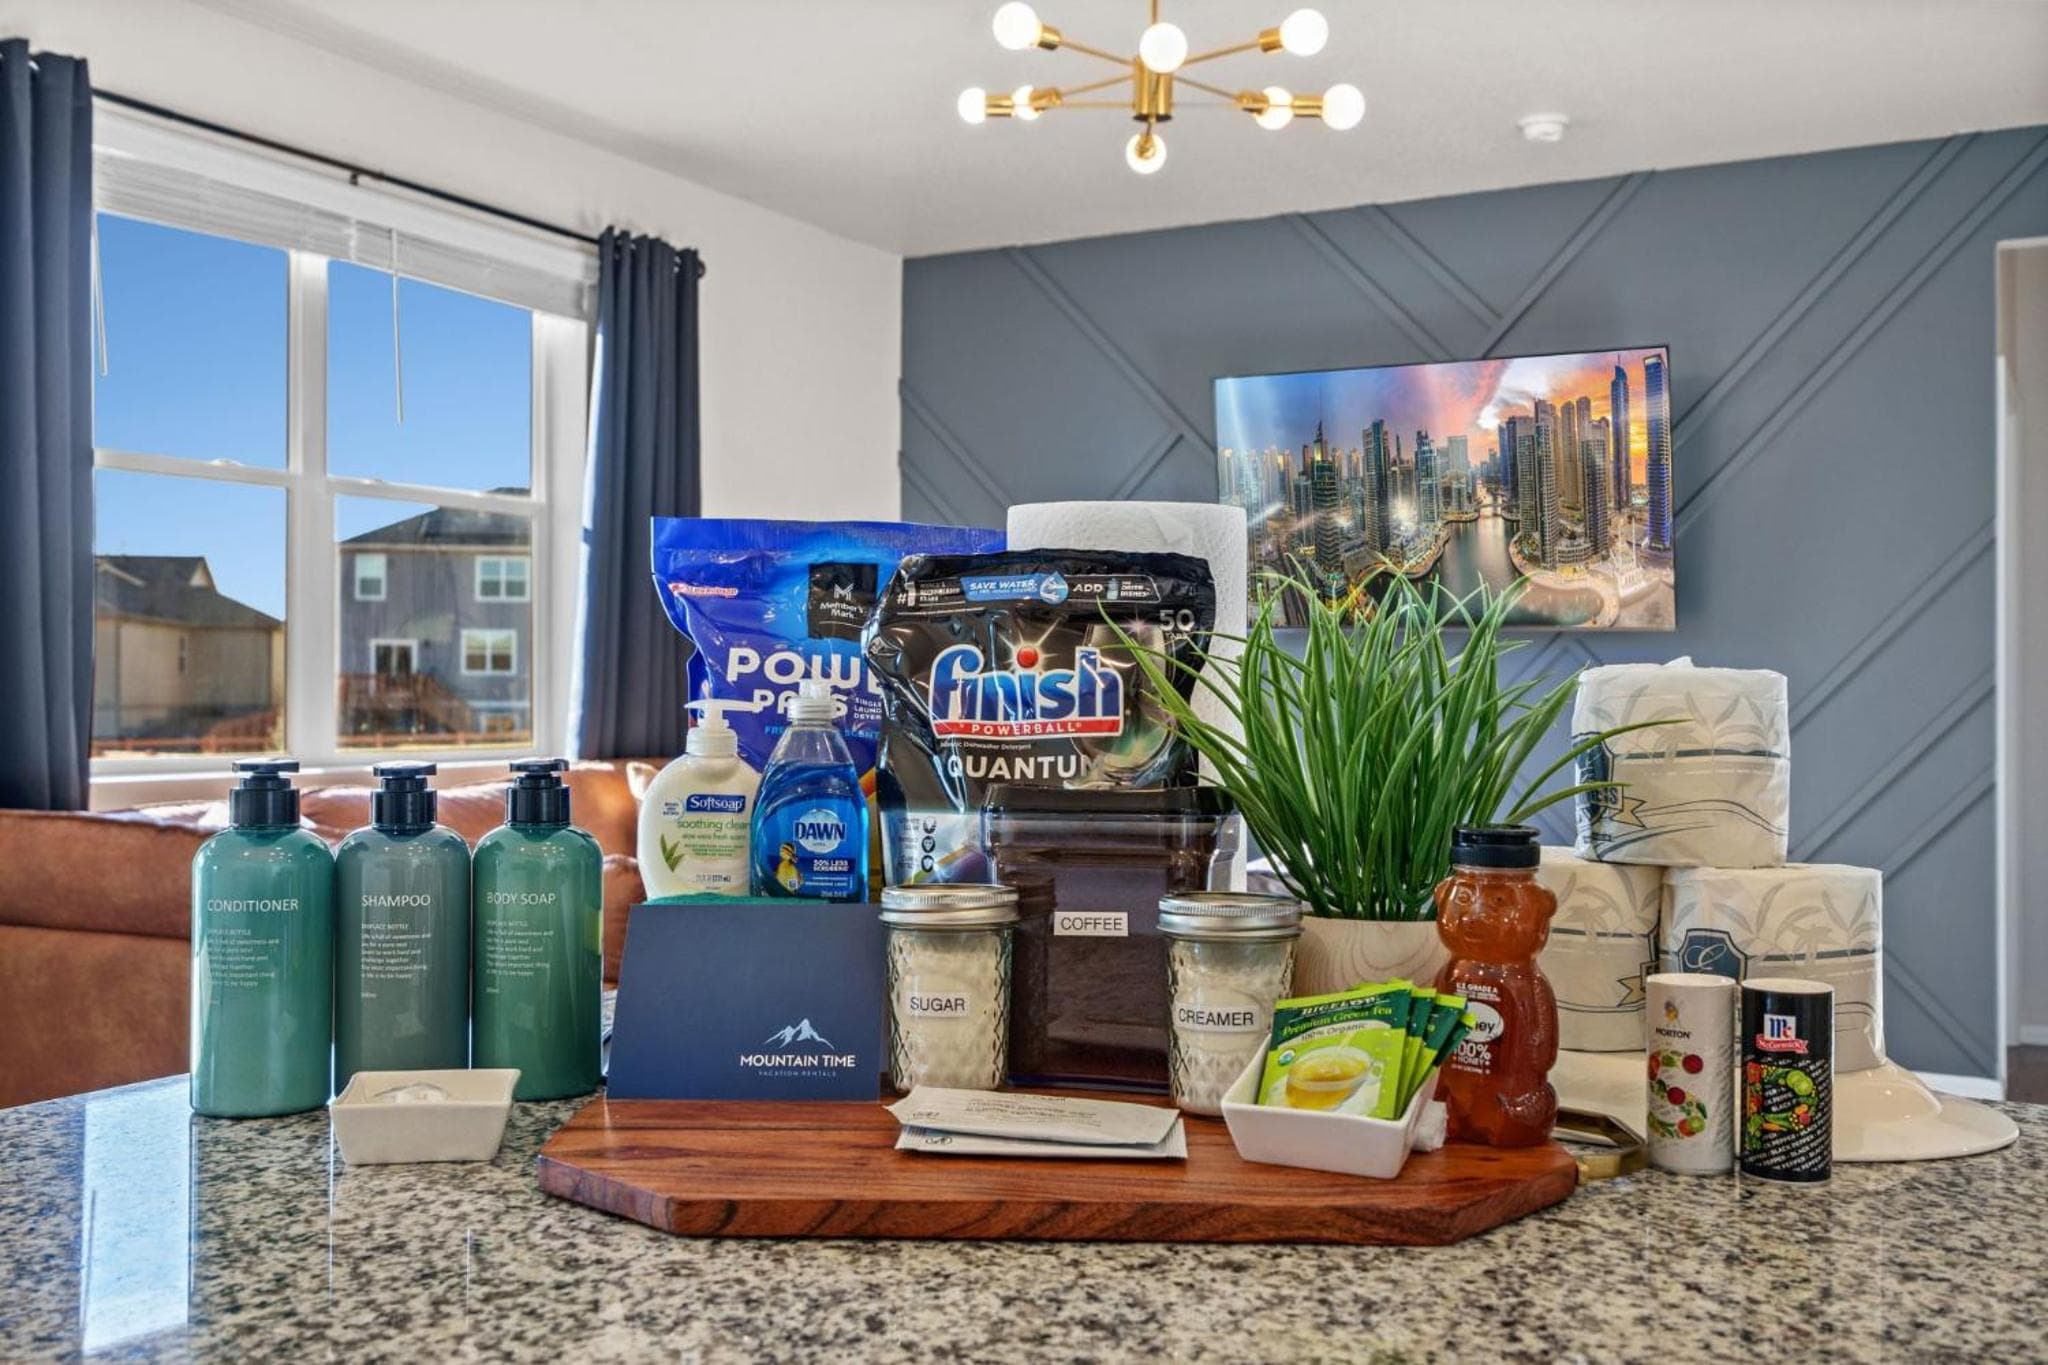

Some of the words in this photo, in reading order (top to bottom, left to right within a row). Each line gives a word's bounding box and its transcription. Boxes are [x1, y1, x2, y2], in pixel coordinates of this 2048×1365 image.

[969, 581, 997, 591] SAVE
[1073, 583, 1103, 593] ADD
[820, 602, 864, 614] Member's
[831, 608, 854, 619] Mark
[1159, 608, 1195, 632] 50
[931, 645, 1121, 722] finish
[971, 722, 1077, 735] POWERBALL
[690, 796, 743, 811] Softsoap
[677, 818, 723, 832] soothing
[794, 822, 846, 841] DAWN
[207, 899, 300, 912] CONDITIONER
[361, 894, 432, 908] SHAMPOO
[486, 892, 517, 904] BODY
[520, 893, 557, 905] SOAP
[1060, 916, 1124, 931] COFFEE
[910, 996, 966, 1013] SUGAR
[1178, 1007, 1255, 1027] CREAMER
[1281, 1016, 1333, 1037] Premium
[739, 1054, 819, 1068] MOUNTAIN
[822, 1054, 857, 1068] TIME
